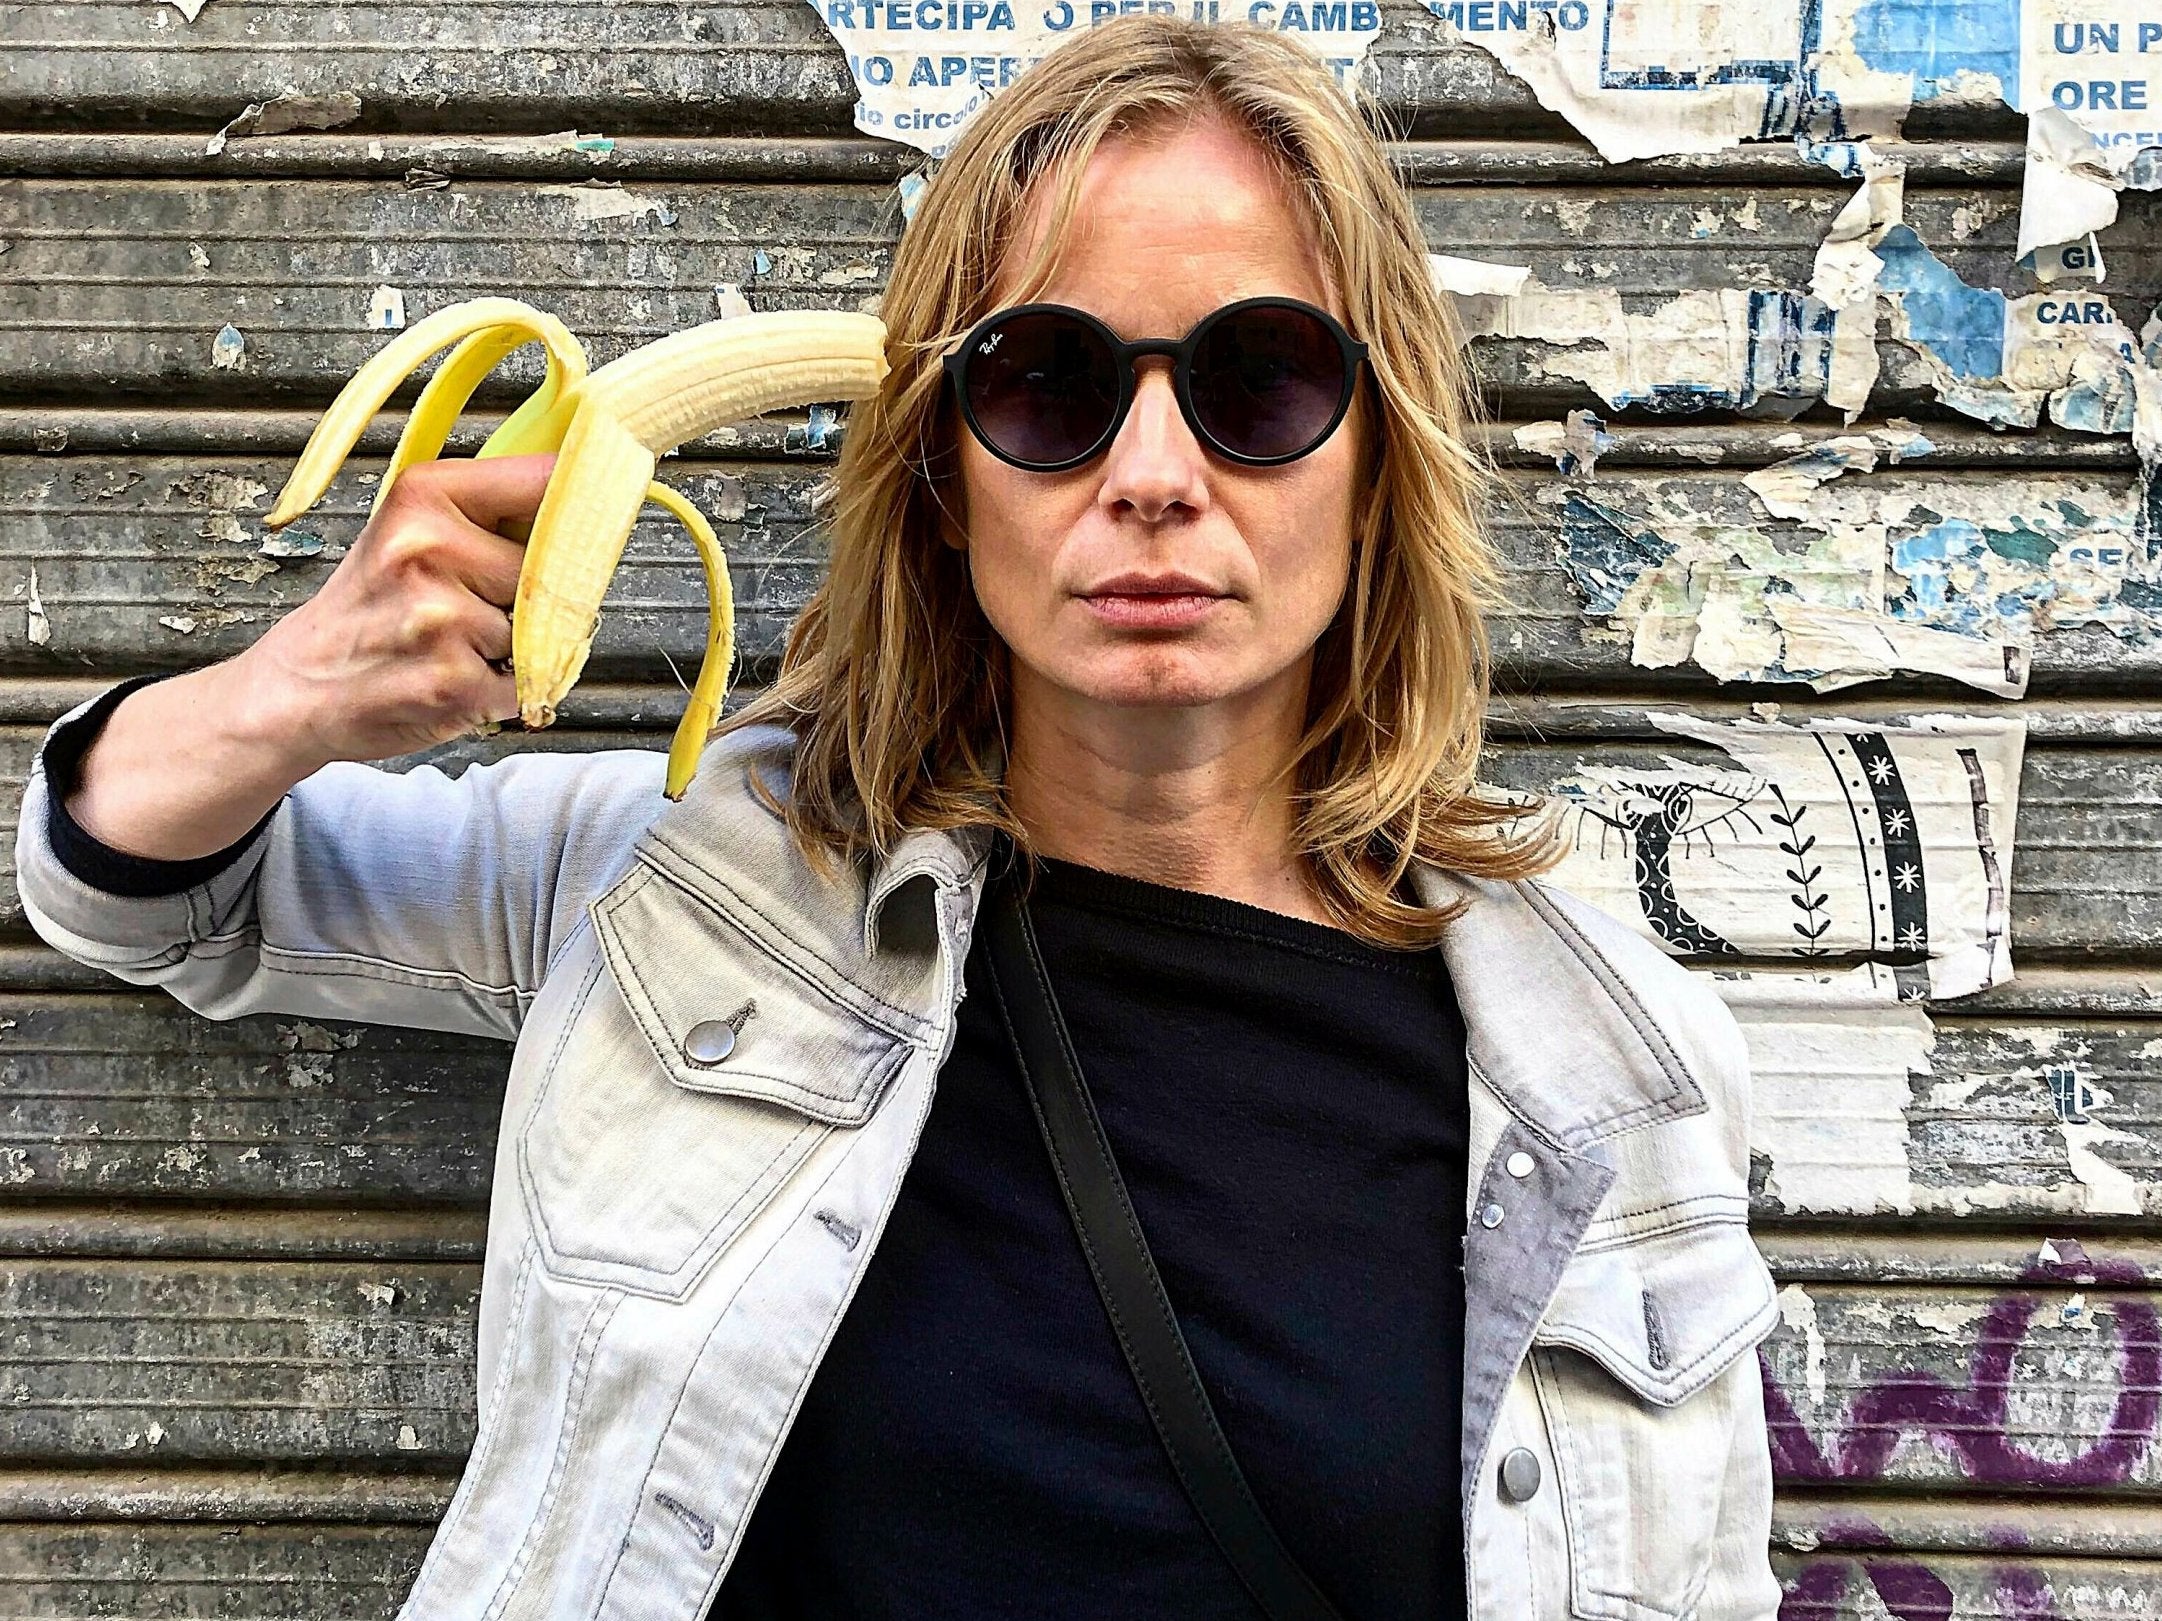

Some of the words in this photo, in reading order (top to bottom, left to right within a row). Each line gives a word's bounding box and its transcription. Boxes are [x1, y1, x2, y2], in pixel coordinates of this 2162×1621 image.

[2053, 23, 2119, 53] UN
[2052, 80, 2148, 111] ORE
[2036, 301, 2113, 325] CAR
